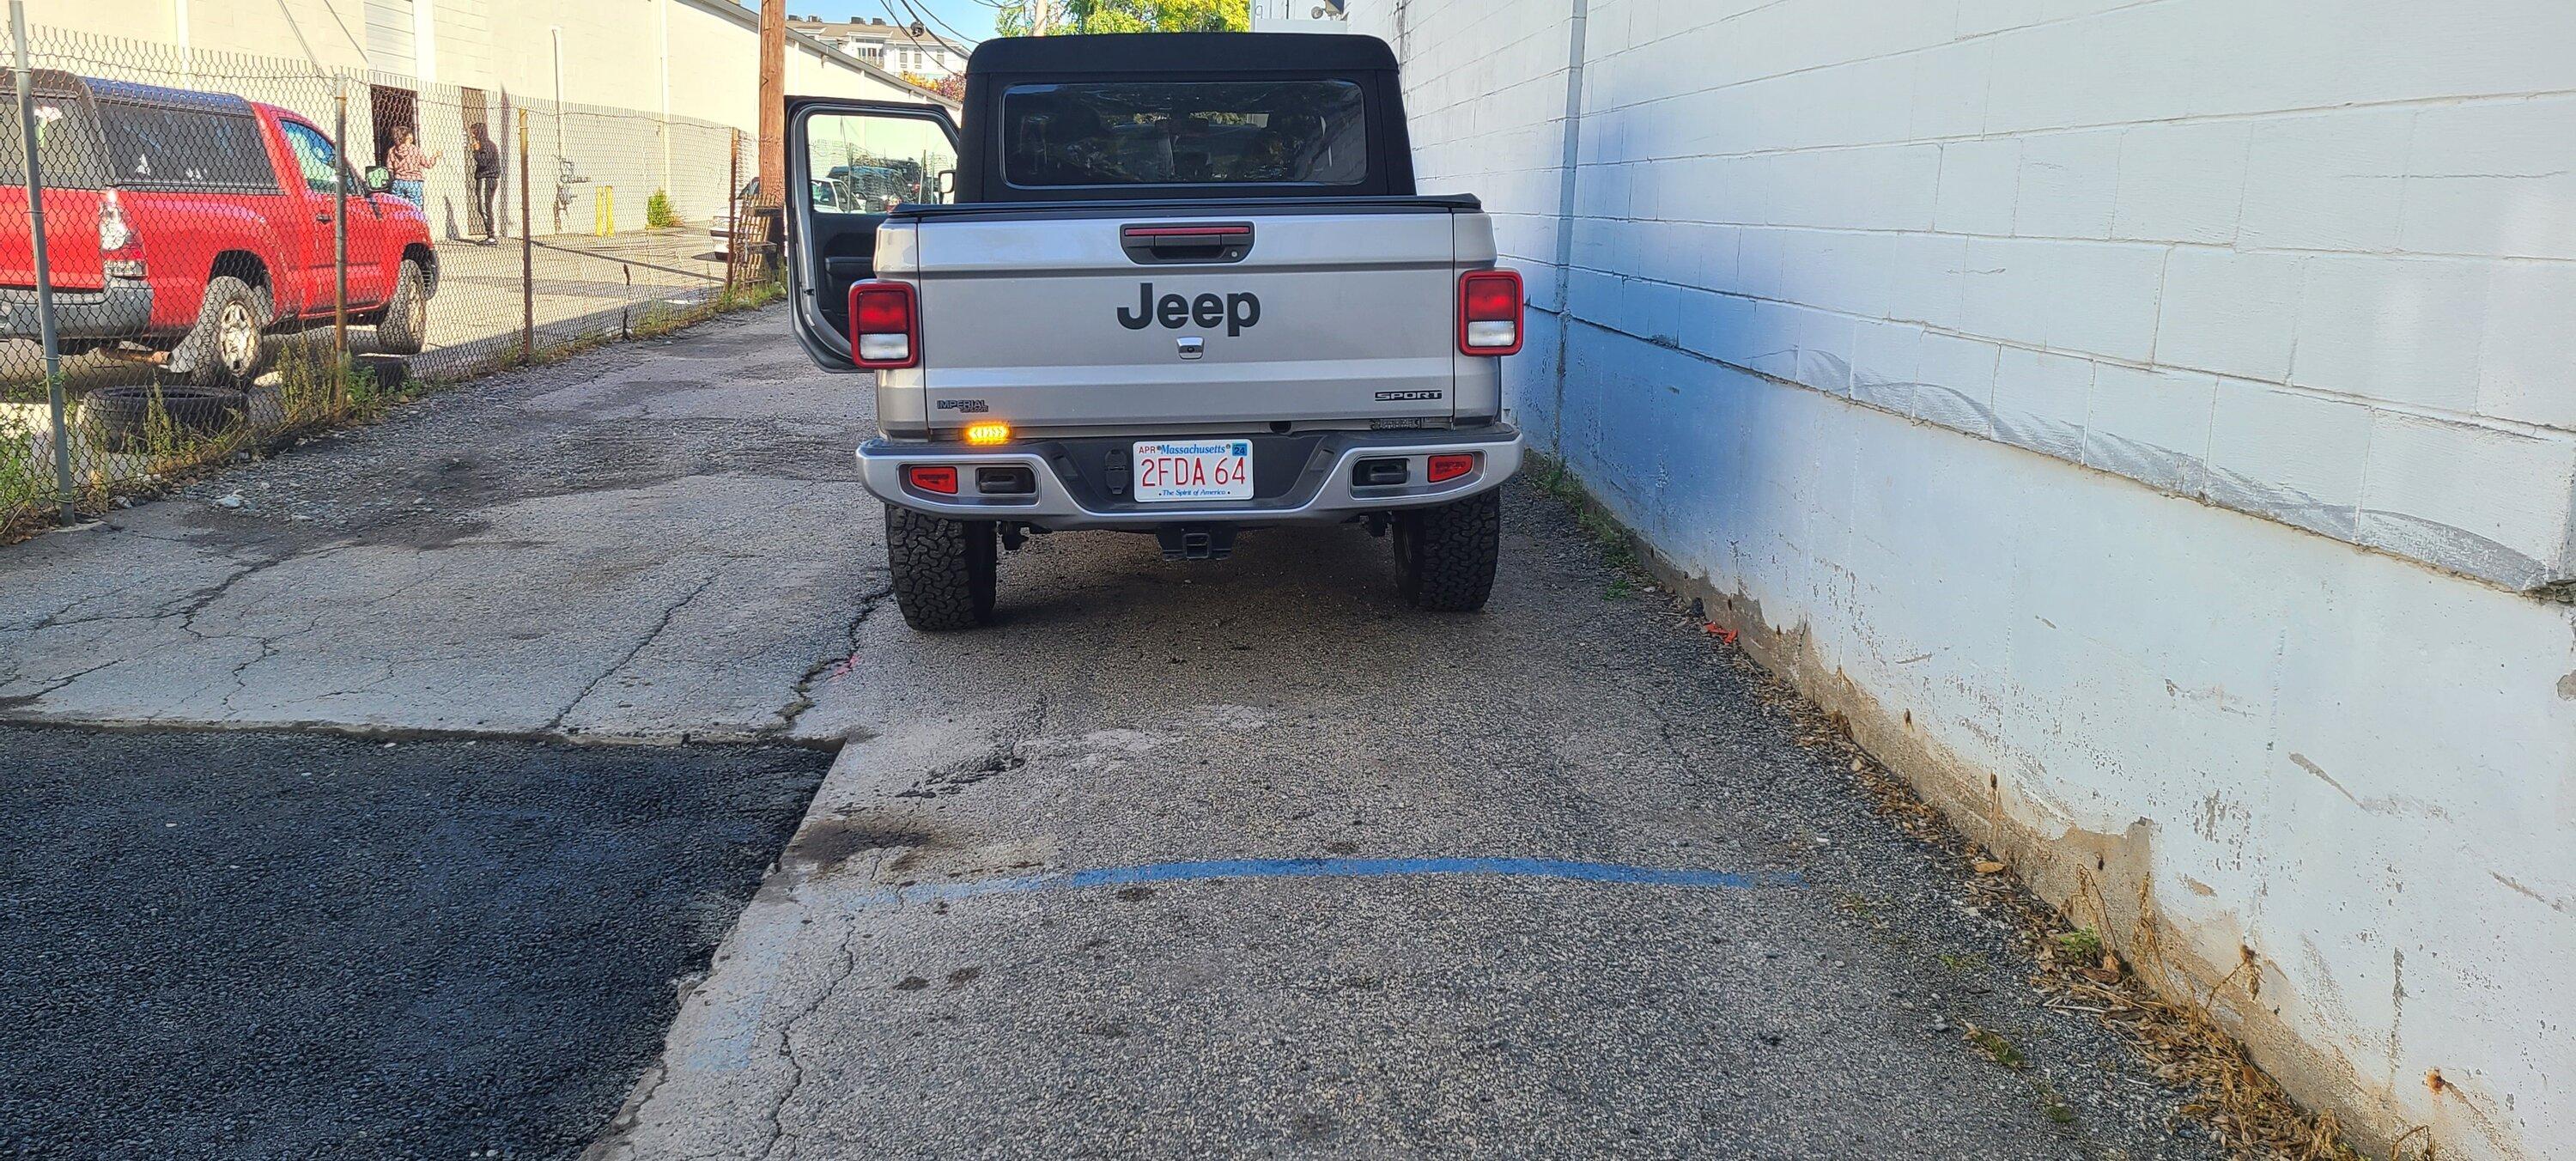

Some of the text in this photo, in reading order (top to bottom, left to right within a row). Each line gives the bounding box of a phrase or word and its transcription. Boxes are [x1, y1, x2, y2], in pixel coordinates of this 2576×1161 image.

[1117, 283, 1261, 337] Jeep
[1375, 391, 1442, 400] SPORT
[937, 400, 986, 409] IMPERIAL
[1160, 444, 1225, 454] Massachusetts
[1234, 447, 1245, 455] 24
[1141, 457, 1245, 486] 2FDA 64
